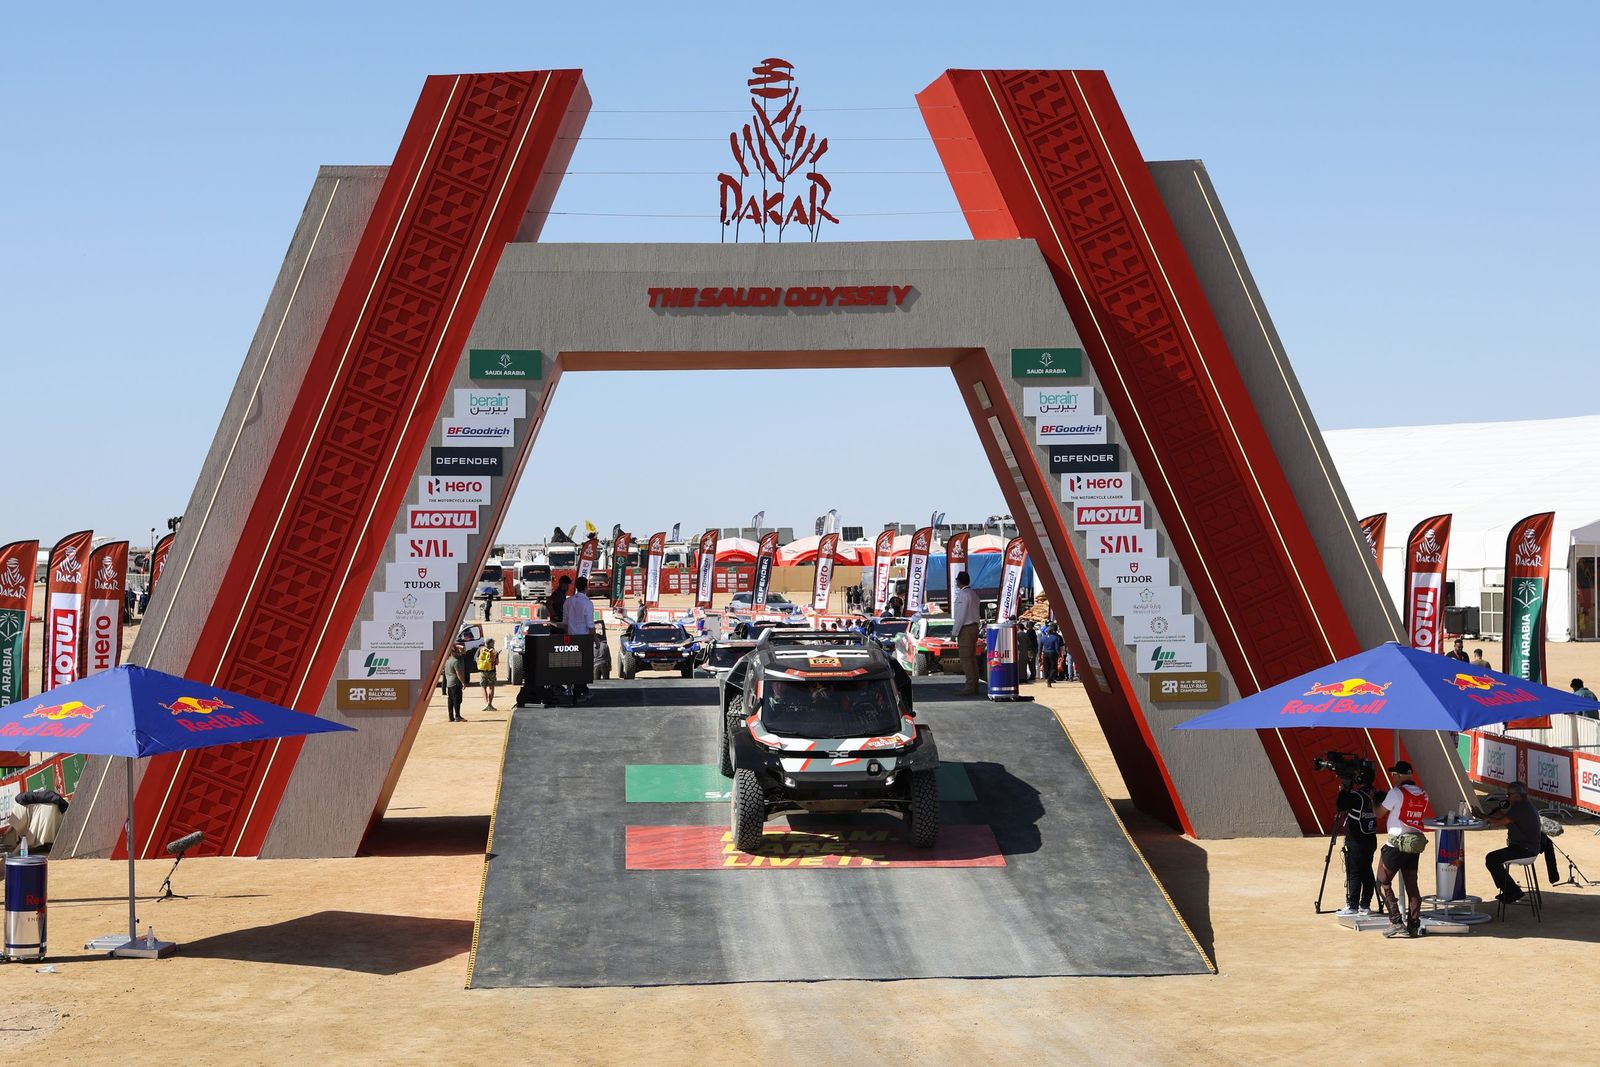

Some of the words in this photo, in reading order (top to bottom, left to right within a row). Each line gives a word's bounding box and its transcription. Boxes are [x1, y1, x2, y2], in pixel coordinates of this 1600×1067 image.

[718, 172, 840, 226] DAKAR
[647, 287, 698, 308] THE
[698, 287, 783, 307] SAUDI
[783, 285, 913, 307] ODYSSEY
[470, 393, 509, 407] berain
[1039, 390, 1078, 405] berain
[447, 426, 510, 436] BFGoodrich
[1040, 424, 1102, 434] BFGoodrich
[436, 457, 498, 465] DEFENDER
[1053, 454, 1114, 463] DEFENDER
[445, 481, 483, 492] Hero
[1086, 478, 1123, 489] Hero
[414, 512, 474, 527] MOTUL
[1080, 508, 1139, 523] MOTUL
[1415, 551, 1442, 564] DAKAR
[1515, 553, 1543, 567] DAKAR
[55, 571, 83, 585] DAKAR
[94, 578, 119, 591] DAKAR
[404, 581, 441, 589] TUDOR
[756, 558, 769, 603] DEFENDER
[820, 565, 829, 591] Hero
[912, 566, 922, 599] TUDOR
[1116, 575, 1153, 584] TUDOR
[94, 615, 112, 669] Hero
[1521, 613, 1531, 657] ARABIA
[2, 647, 13, 693] ARABIA
[1467, 692, 1502, 708] Red
[1497, 687, 1541, 704] Bull
[1279, 699, 1332, 715] Red
[1330, 699, 1388, 715] Bull
[177, 713, 222, 733] Red
[217, 710, 264, 728] Bull
[0, 721, 41, 737] Red
[41, 722, 94, 738] Bull
[1487, 745, 1506, 767] berain
[1537, 757, 1559, 779] berain
[721, 854, 828, 867] LIVE
